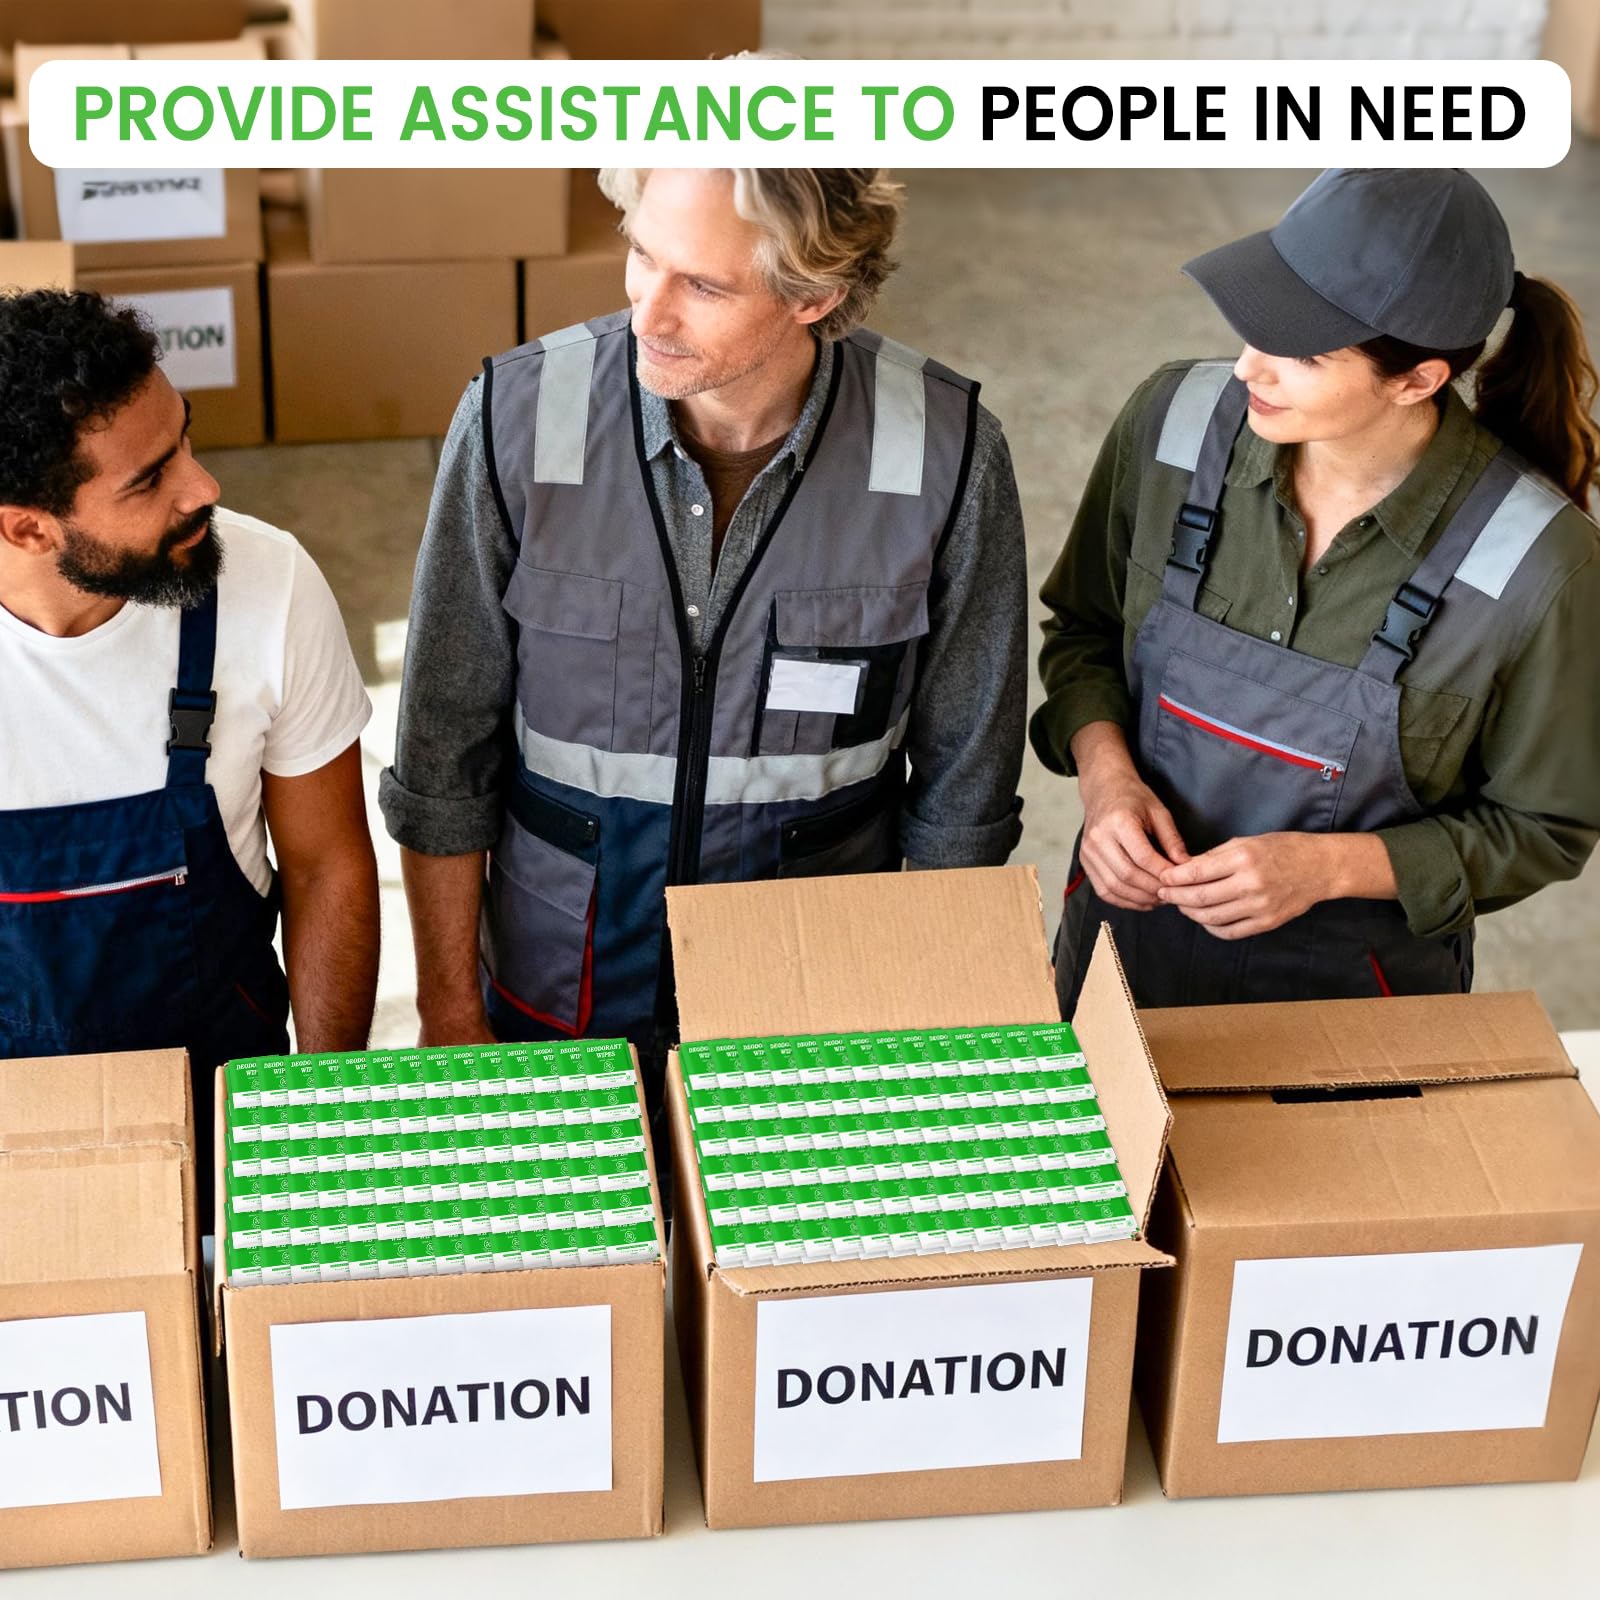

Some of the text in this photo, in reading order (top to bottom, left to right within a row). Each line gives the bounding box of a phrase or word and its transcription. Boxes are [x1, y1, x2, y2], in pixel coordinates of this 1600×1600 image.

[586, 1043, 622, 1053] DEODORANT
[596, 1051, 616, 1059] WIPES
[1247, 1316, 1538, 1367] DONATION
[778, 1348, 1066, 1408] DONATION
[297, 1376, 589, 1434] DONATION
